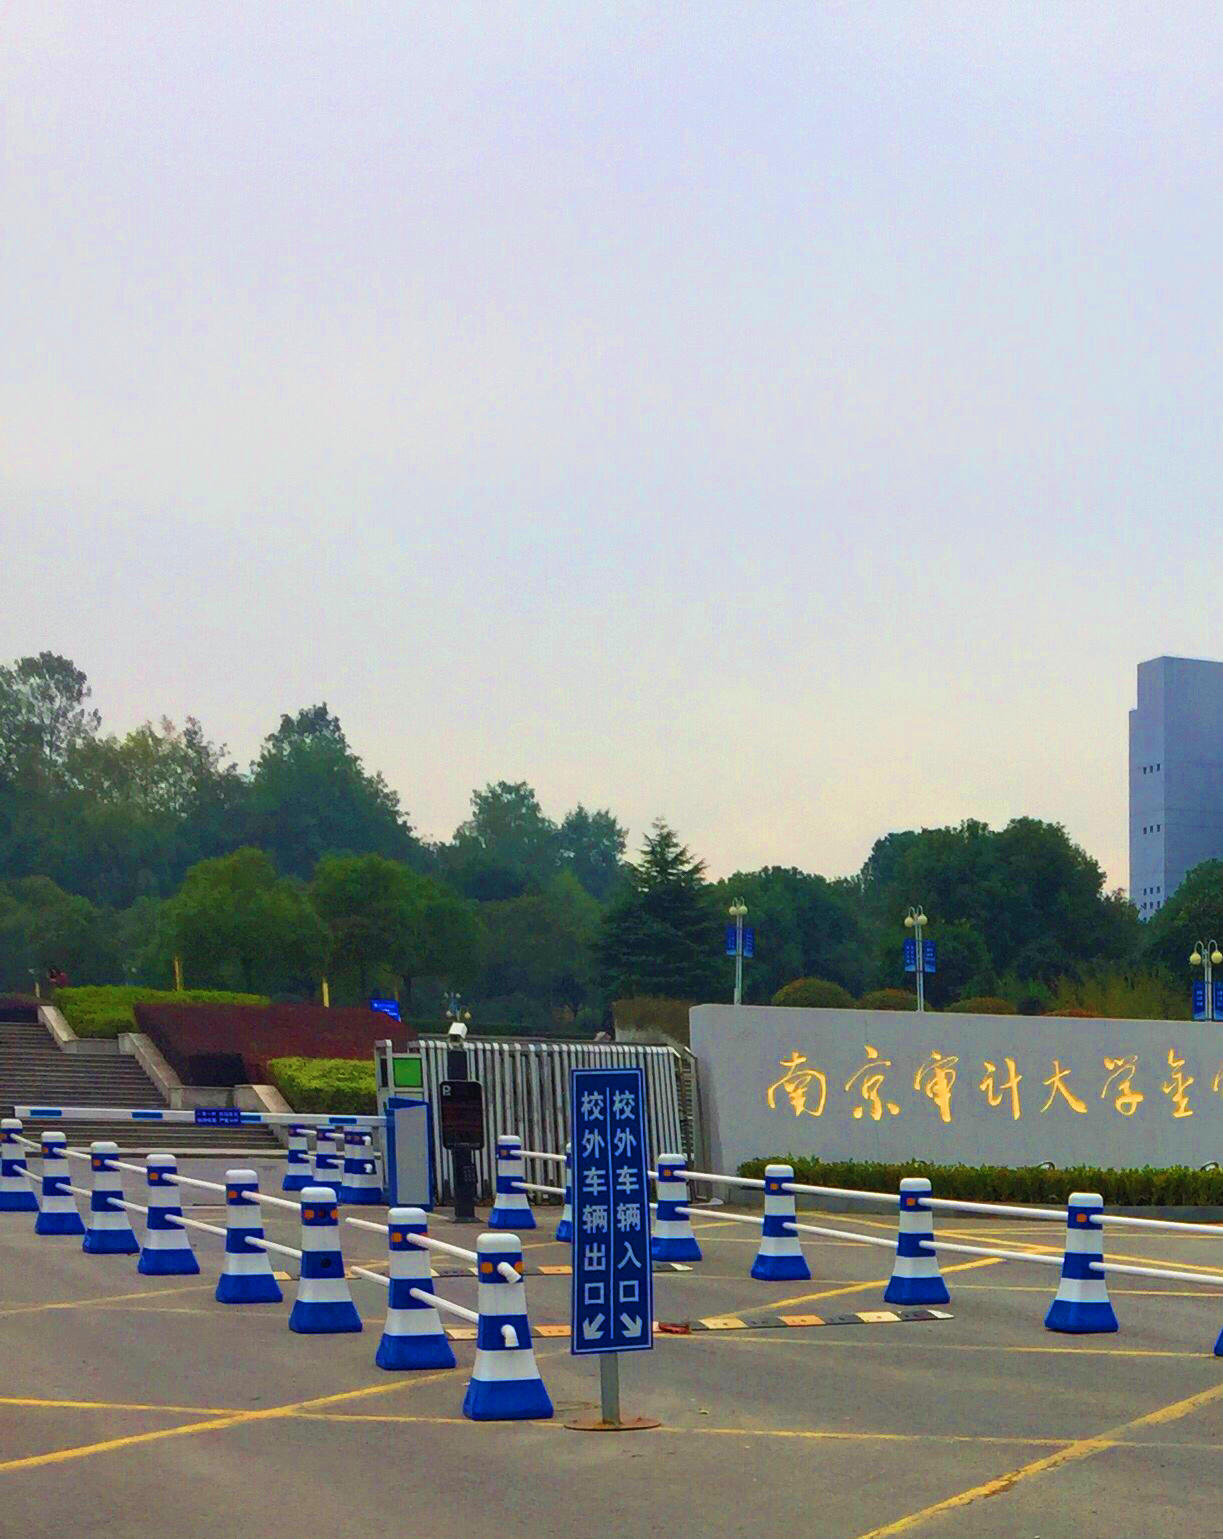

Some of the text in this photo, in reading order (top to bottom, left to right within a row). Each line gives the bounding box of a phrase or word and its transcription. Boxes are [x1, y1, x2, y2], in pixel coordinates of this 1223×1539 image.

[581, 1091, 608, 1304] 校外车辆出口
[612, 1090, 642, 1303] 校外车辆入口
